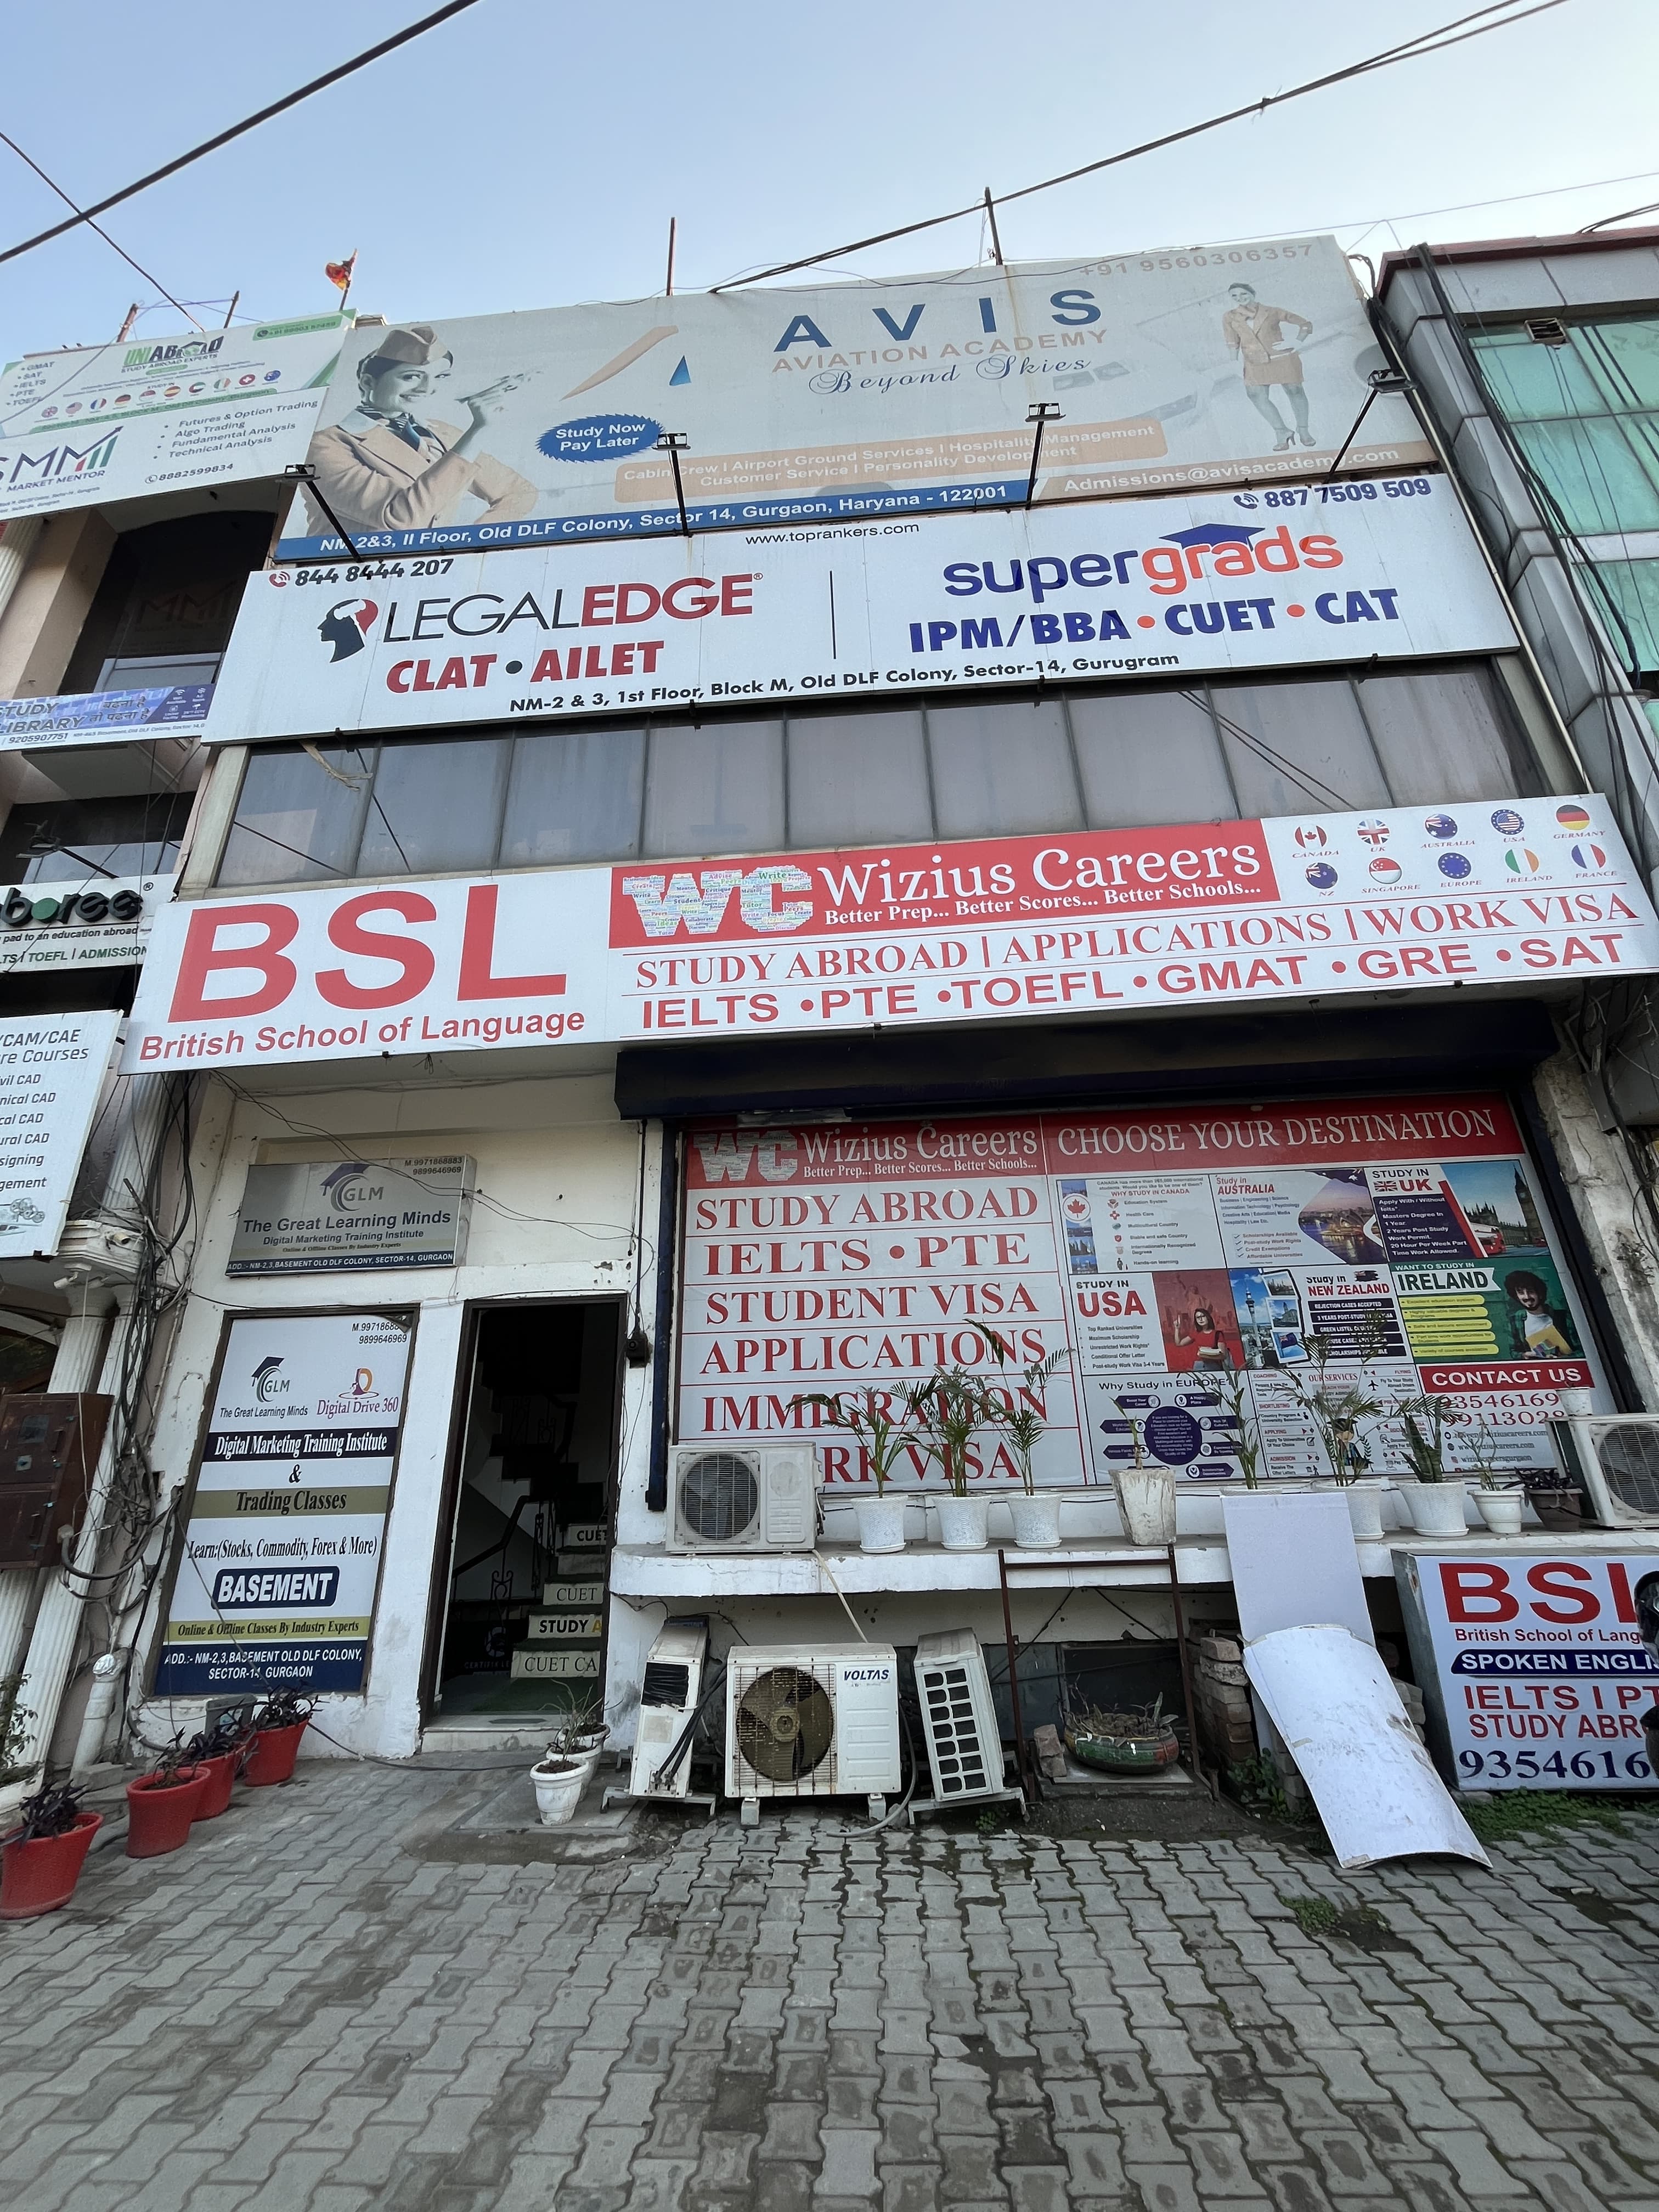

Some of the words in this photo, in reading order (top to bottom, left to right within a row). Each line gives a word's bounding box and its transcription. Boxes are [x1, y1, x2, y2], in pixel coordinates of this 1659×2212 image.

[1080, 261, 1127, 277] +91
[1139, 244, 1312, 273] 9560306357
[774, 289, 1102, 352] AVIS
[772, 346, 928, 373] AVIATION
[939, 330, 1108, 358] ACADEMY
[809, 365, 961, 395] Beyond
[976, 354, 1092, 380] Skies
[179, 416, 221, 427] Futures
[235, 407, 273, 419] Option
[276, 400, 318, 411] Trading
[172, 431, 245, 448] Fundamental
[249, 423, 296, 436] Analysis
[175, 428, 200, 438] Algo
[204, 422, 245, 433] Trading
[555, 425, 603, 440] Study
[608, 421, 646, 434] Now
[170, 444, 223, 458] Technical
[225, 436, 272, 449] Analysis
[560, 439, 592, 453] Pay
[597, 436, 639, 449] Later
[733, 456, 789, 472] Airport
[795, 452, 856, 465] Ground
[862, 445, 933, 460] Services
[7, 478, 54, 492] MARKET
[57, 470, 105, 483] MENTOR
[159, 464, 233, 481] 8882599834
[742, 499, 833, 519] Gurgaon,
[838, 493, 919, 511] Haryana
[939, 486, 1007, 502] 122001
[1265, 489, 1308, 508] 887
[1321, 483, 1378, 504] 7509
[1383, 479, 1431, 498] 509
[745, 522, 920, 547] www.toprankers.com
[295, 568, 338, 586] 844
[346, 562, 405, 583] 8444
[410, 558, 454, 578] 207
[943, 523, 1345, 603] supergrads
[910, 612, 1132, 653] IPM/BBA
[1166, 597, 1276, 637] CUET
[1315, 588, 1399, 622] CAT
[386, 653, 497, 695] CLAT
[529, 640, 664, 683] AILET
[652, 685, 704, 702] Floor,
[712, 680, 764, 695] Block
[800, 674, 837, 690] Old
[843, 670, 879, 687] DLF
[886, 665, 956, 684] Colony,
[963, 659, 1068, 679] Sector-14,
[1072, 653, 1180, 674] Gurugram
[8, 733, 68, 744] 9205907751
[1421, 839, 1475, 849] AUSTRALIA
[1553, 831, 1606, 839] GERMANY
[1292, 850, 1339, 859] CANADA
[817, 854, 1016, 906] Wizius
[1032, 845, 1261, 891] Careers
[1440, 879, 1482, 888] EUROPE
[1361, 884, 1421, 894] SINGAPORE
[825, 909, 883, 926] Better
[888, 905, 950, 923] Prep...
[956, 898, 1013, 916] Better
[1019, 895, 1099, 911] Scores...
[1104, 886, 1164, 905] Better
[1170, 880, 1261, 899] Schools...
[52, 930, 100, 939] education
[104, 927, 138, 936] abroad
[636, 952, 776, 989] STUDY
[785, 941, 968, 979] ABROAD
[1003, 912, 1331, 963] APPLICATIONS
[1362, 899, 1519, 936] WORK
[1521, 892, 1640, 924] VISA
[29, 951, 67, 962] TOEFL
[168, 884, 567, 1023] BSL
[642, 994, 778, 1029] IELTS
[140, 1034, 244, 1060] British
[255, 1020, 367, 1052] School
[379, 1017, 413, 1042] of
[421, 1012, 585, 1042] Language
[22, 1047, 89, 1062] Courses
[17, 1074, 41, 1084] CAD
[31, 1093, 55, 1103] CAD
[1058, 1125, 1185, 1156] CHOOSE
[1189, 1120, 1280, 1150] YOUR
[1282, 1109, 1497, 1146] DESTINATION
[413, 1167, 461, 1175] 9899646969
[1372, 1169, 1413, 1178] STUDY
[1417, 1168, 1430, 1176] IN
[344, 1186, 384, 1202] GLM
[1217, 1184, 1275, 1195] AUSTRALIA
[1400, 1178, 1433, 1192] UK
[244, 1220, 272, 1233] The
[277, 1217, 321, 1232] Great
[326, 1214, 397, 1229] Learning
[402, 1211, 451, 1225] Minds
[263, 1235, 293, 1246] Digital
[296, 1233, 342, 1244] Marketing
[345, 1232, 383, 1242] Training
[386, 1229, 424, 1239] Institute
[1308, 1285, 1334, 1296] NEW
[1338, 1283, 1390, 1295] ZEALAND
[1398, 1271, 1488, 1290] IRELAND
[1077, 1290, 1147, 1317] USA
[359, 1334, 407, 1344] 9899646969
[699, 1329, 1046, 1374] APPLICATIONS
[1099, 1382, 1124, 1391] Why
[1126, 1381, 1159, 1390] Study
[1162, 1380, 1173, 1388] in
[1324, 1373, 1358, 1381] SERVICES
[1431, 1369, 1541, 1386] CONTACT
[1548, 1368, 1582, 1382] US
[317, 1400, 351, 1419] Digital
[353, 1399, 380, 1414] Drive
[382, 1397, 398, 1413] 360
[236, 1492, 292, 1515] Trading
[294, 1490, 347, 1510] Classes
[218, 1573, 333, 1602] BASEMENT
[556, 1588, 598, 1601] CUET
[539, 1619, 589, 1633] STUDY
[1462, 1654, 1571, 1670] SPOKEN
[843, 1668, 890, 1681] VOLTAS
[1464, 1685, 1579, 1710] IELTS
